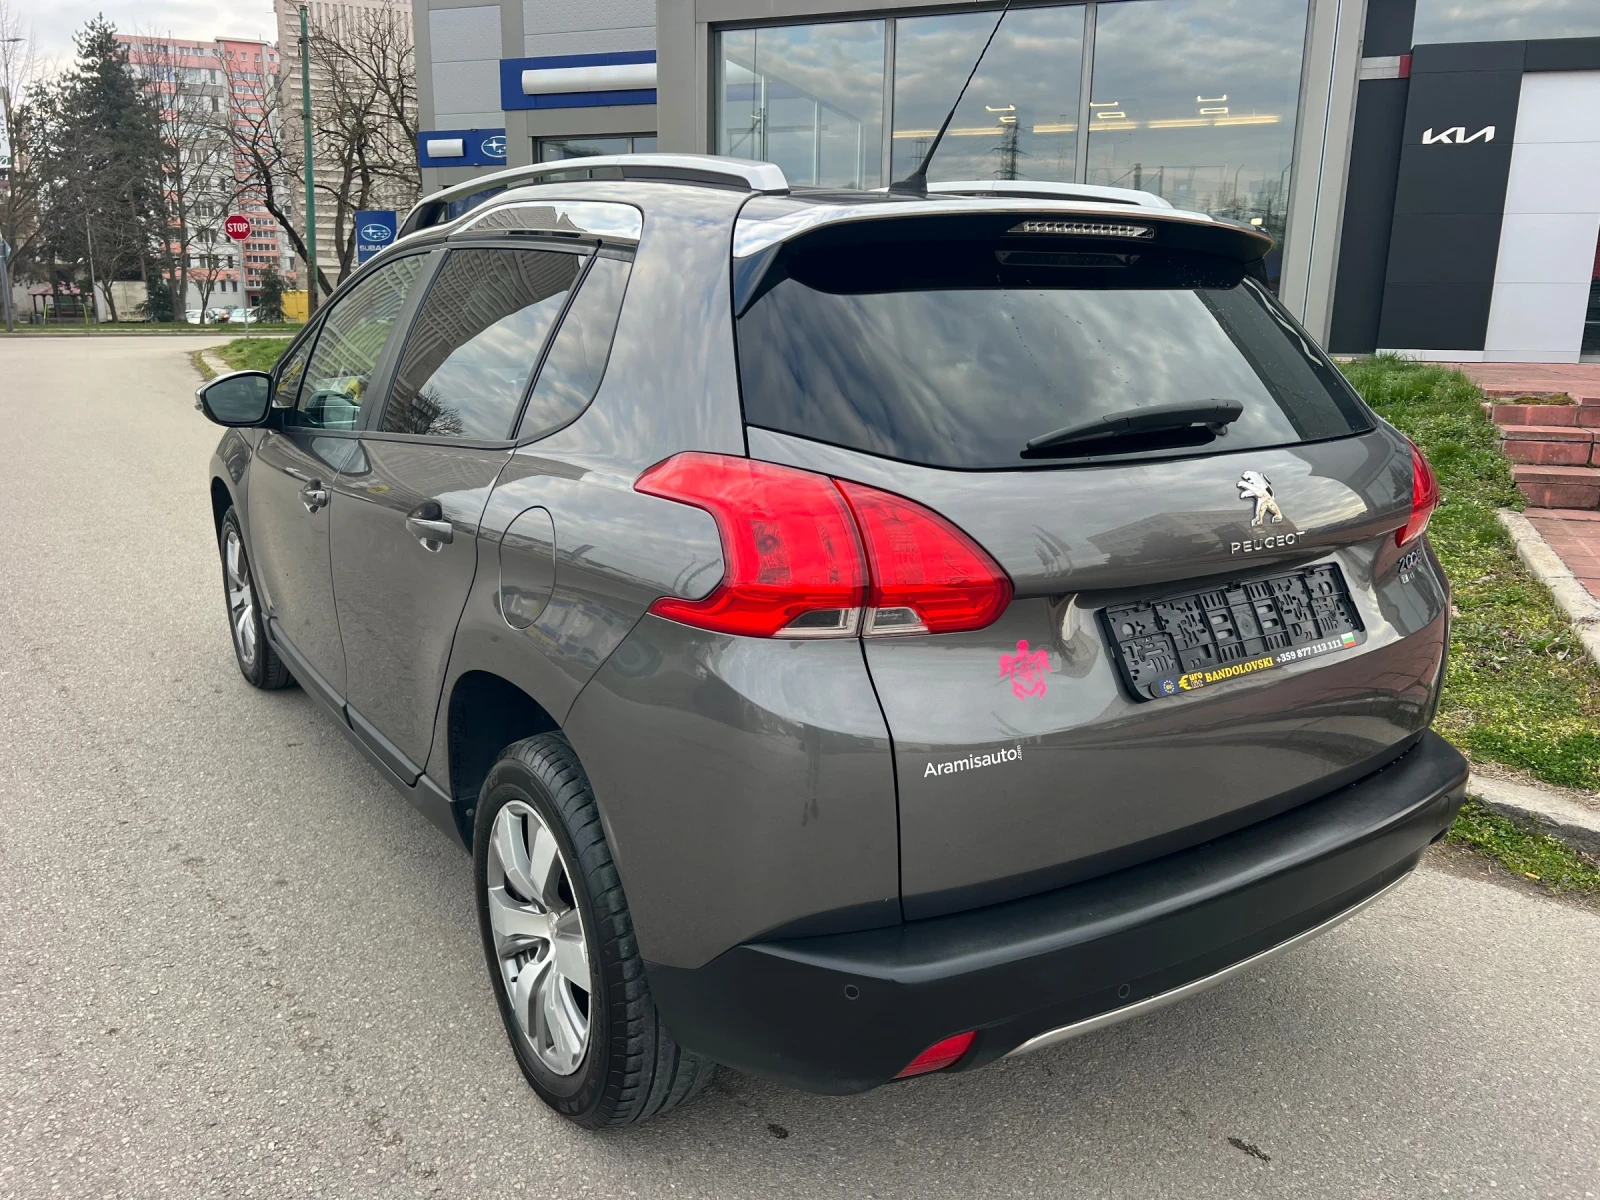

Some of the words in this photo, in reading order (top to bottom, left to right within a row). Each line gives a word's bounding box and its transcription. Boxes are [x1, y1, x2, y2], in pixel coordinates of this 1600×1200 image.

[1421, 125, 1496, 145] KIA
[227, 222, 249, 233] STOP
[1230, 530, 1306, 555] PEUGEOT
[1204, 656, 1274, 683] BANDOLOVSKI
[1276, 650, 1297, 664] +359
[1297, 645, 1312, 659] 877
[1312, 642, 1328, 655] 113
[1327, 638, 1343, 651] 111
[923, 748, 1018, 778] Aramisauto
